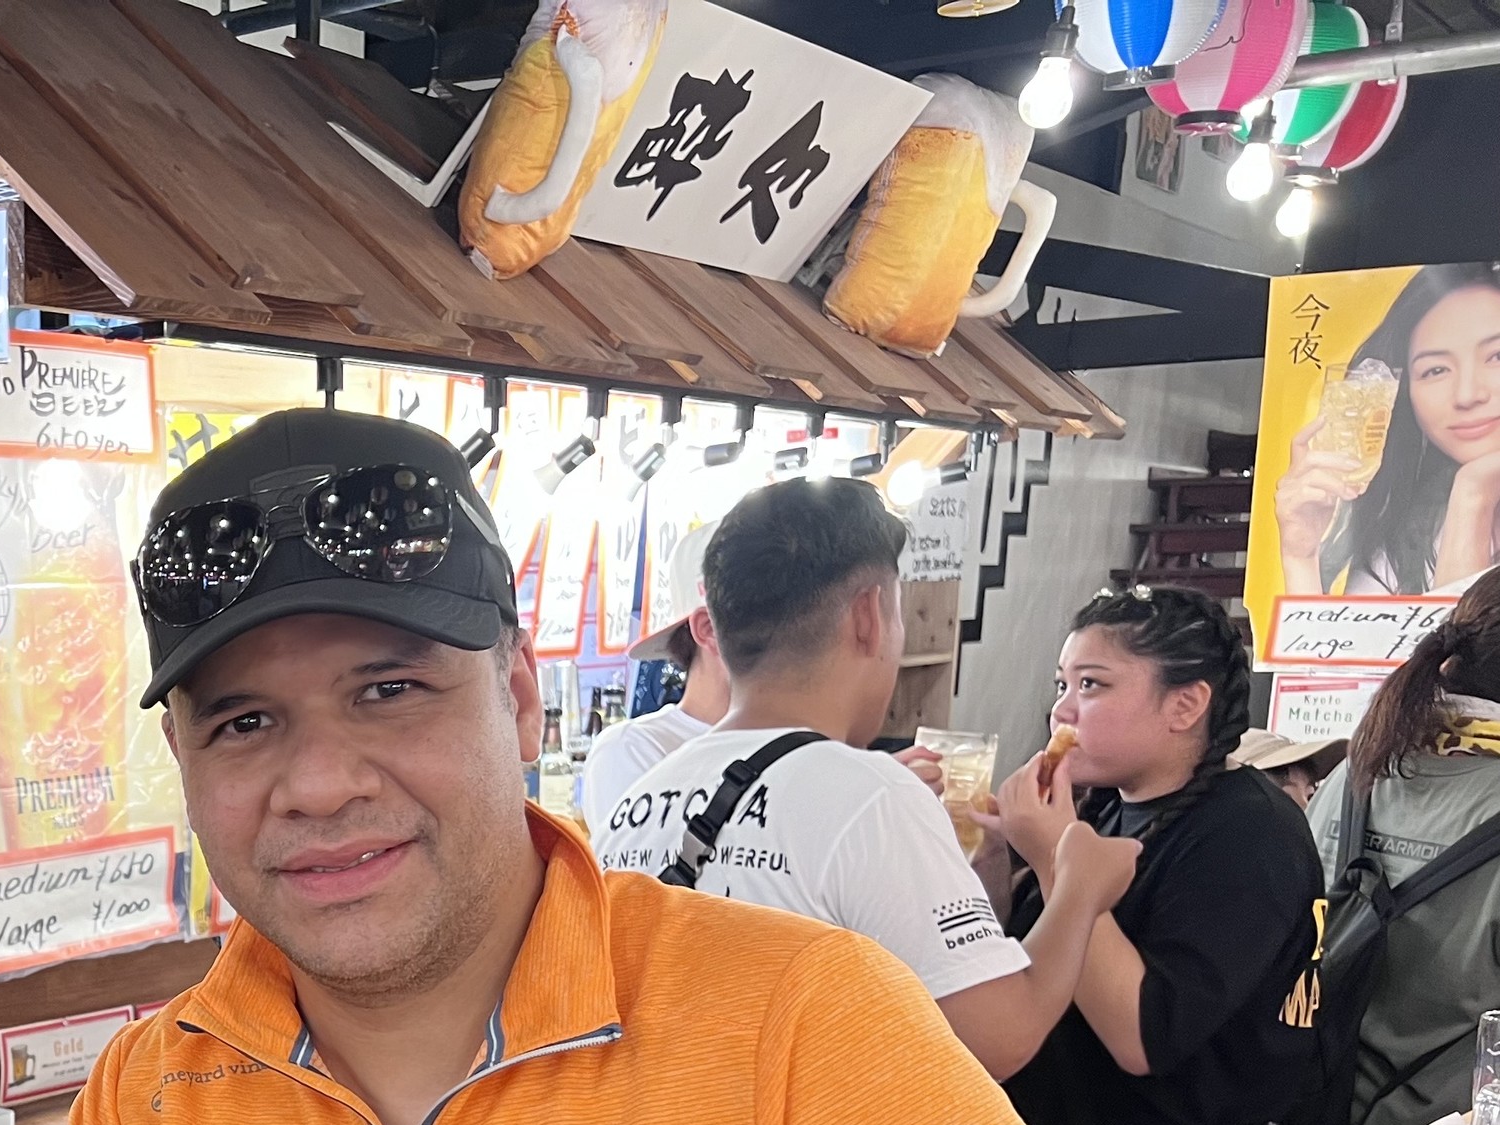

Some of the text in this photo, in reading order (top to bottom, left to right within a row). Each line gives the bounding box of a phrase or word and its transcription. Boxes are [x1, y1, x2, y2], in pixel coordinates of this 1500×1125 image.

[1283, 634, 1354, 658] large
[1303, 694, 1341, 706] Kyoto
[1287, 707, 1353, 722] Matcha
[1304, 724, 1331, 736] Beer
[618, 850, 652, 868] NEW
[945, 925, 993, 950] beach
